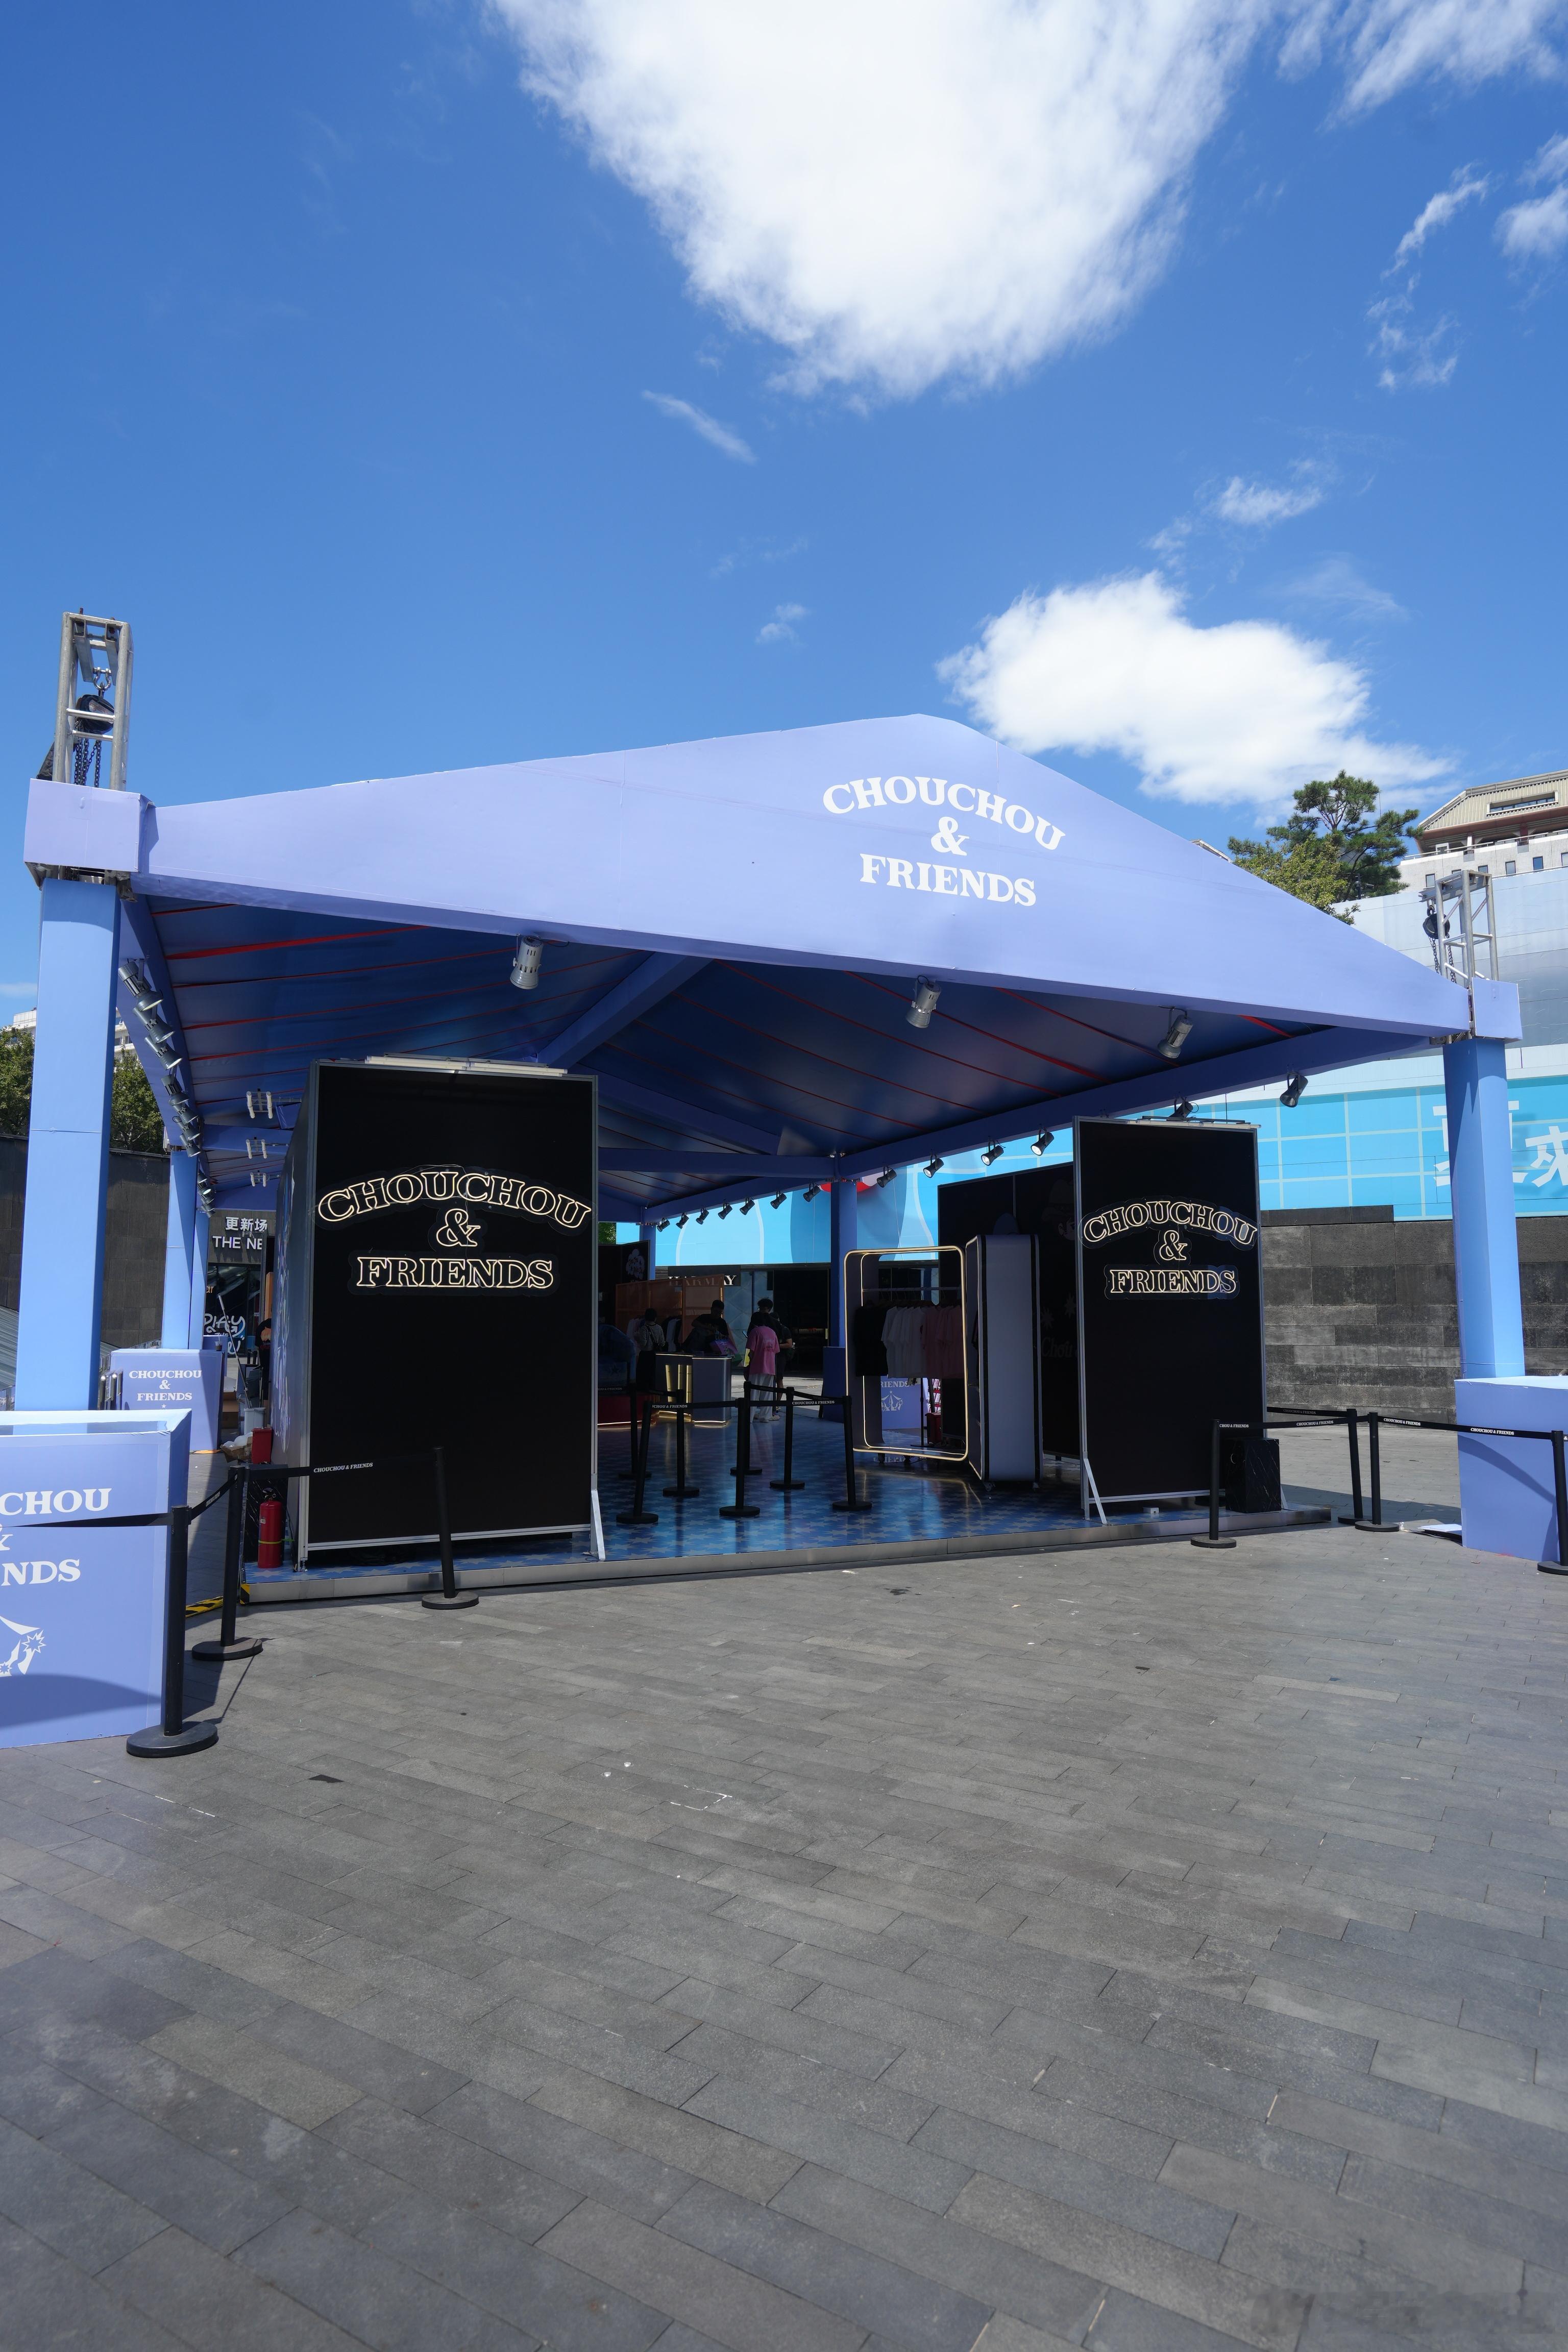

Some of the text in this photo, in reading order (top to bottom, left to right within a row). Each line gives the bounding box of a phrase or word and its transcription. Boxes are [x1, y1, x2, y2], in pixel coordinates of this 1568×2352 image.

[823, 776, 1066, 850] CHOUCHOU
[930, 817, 969, 856] &
[860, 853, 1037, 906] FRIENDS
[318, 1171, 591, 1228] CHOUCHOU
[226, 1216, 267, 1232] 更新场
[436, 1208, 481, 1247] &
[1084, 1201, 1258, 1244] CHOUCHOU
[212, 1236, 241, 1249] THE
[1159, 1230, 1188, 1260] &
[357, 1257, 554, 1289] FRIENDS
[1110, 1269, 1236, 1293] FRIENDS
[129, 1370, 202, 1379] CHOUCHOU
[159, 1380, 172, 1389] &
[137, 1392, 192, 1401] FRIENDS
[313, 1465, 345, 1473] CHOUCHOU
[0, 1488, 112, 1516] CHOU
[1, 1558, 81, 1586] NDS
